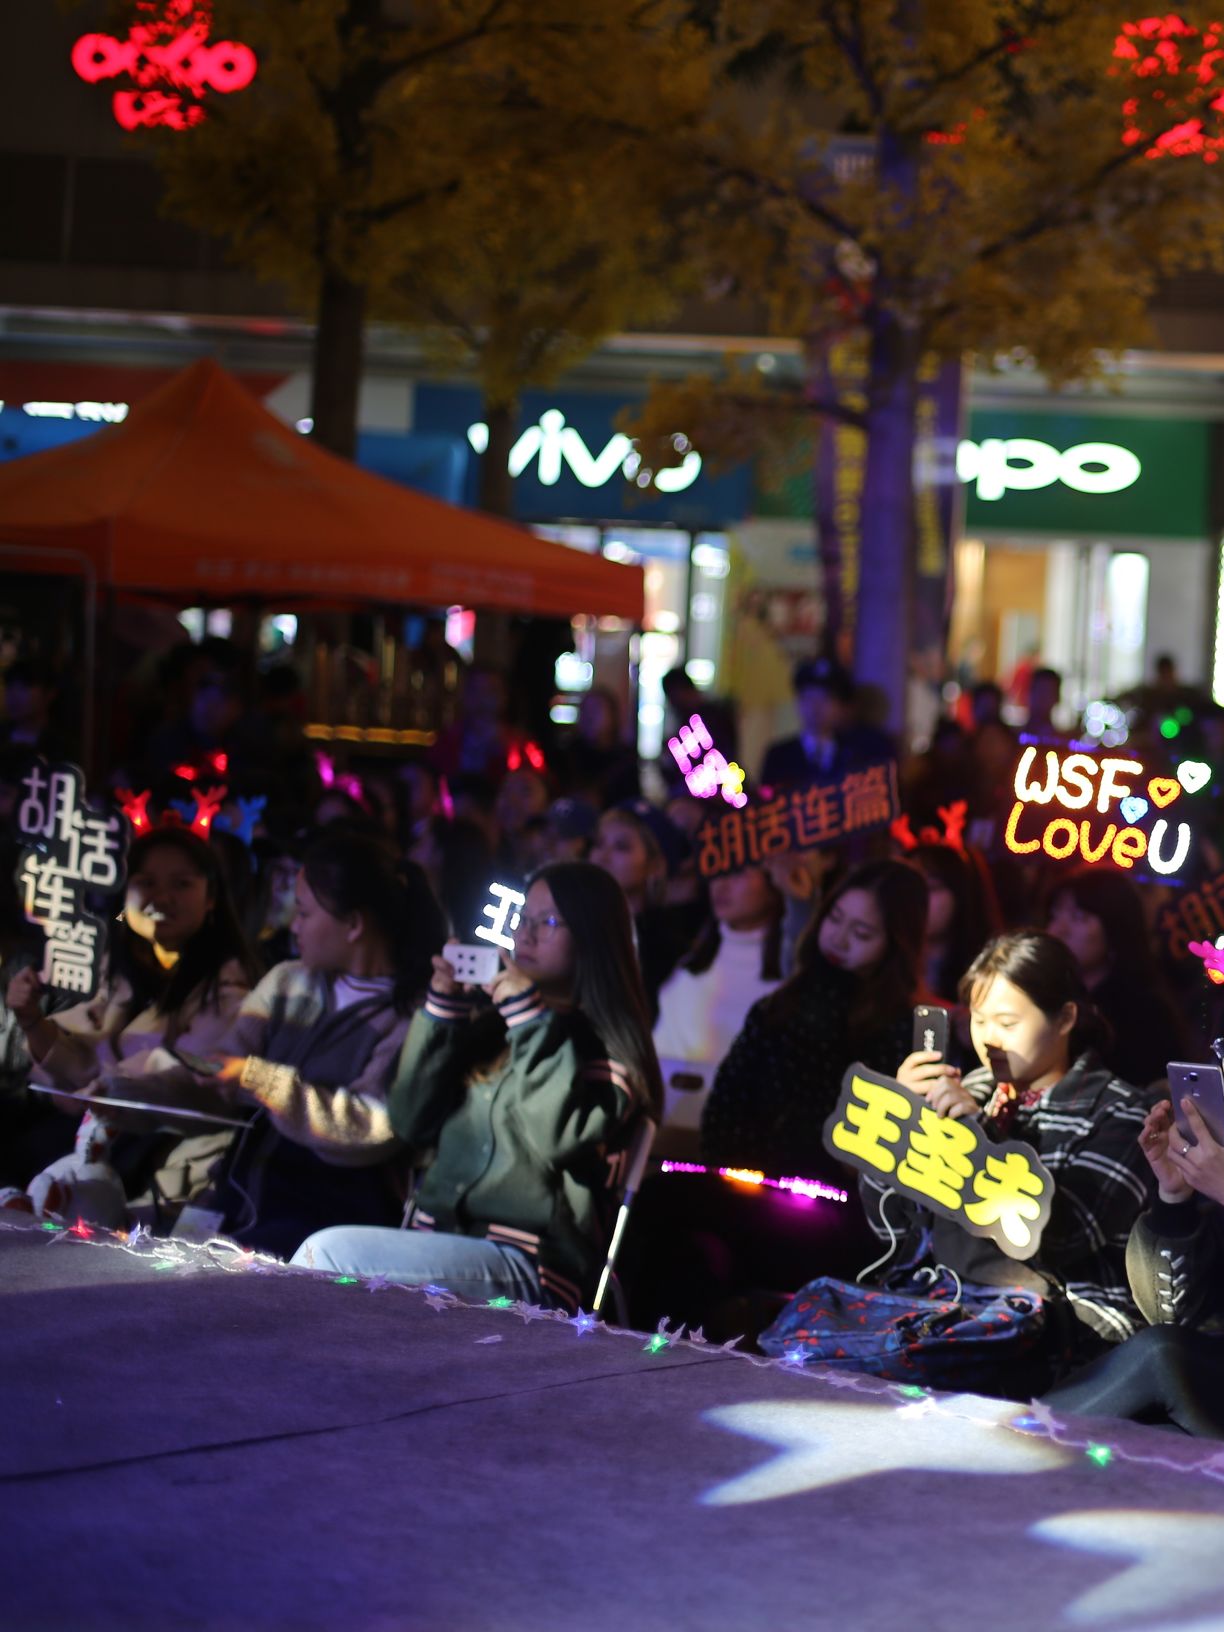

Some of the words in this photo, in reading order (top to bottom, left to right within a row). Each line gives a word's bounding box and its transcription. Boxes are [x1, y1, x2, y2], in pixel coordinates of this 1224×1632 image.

[700, 765, 891, 877] 胡话连篇
[1014, 746, 1144, 814] WSF
[831, 1074, 1054, 1248] 王圣夫
